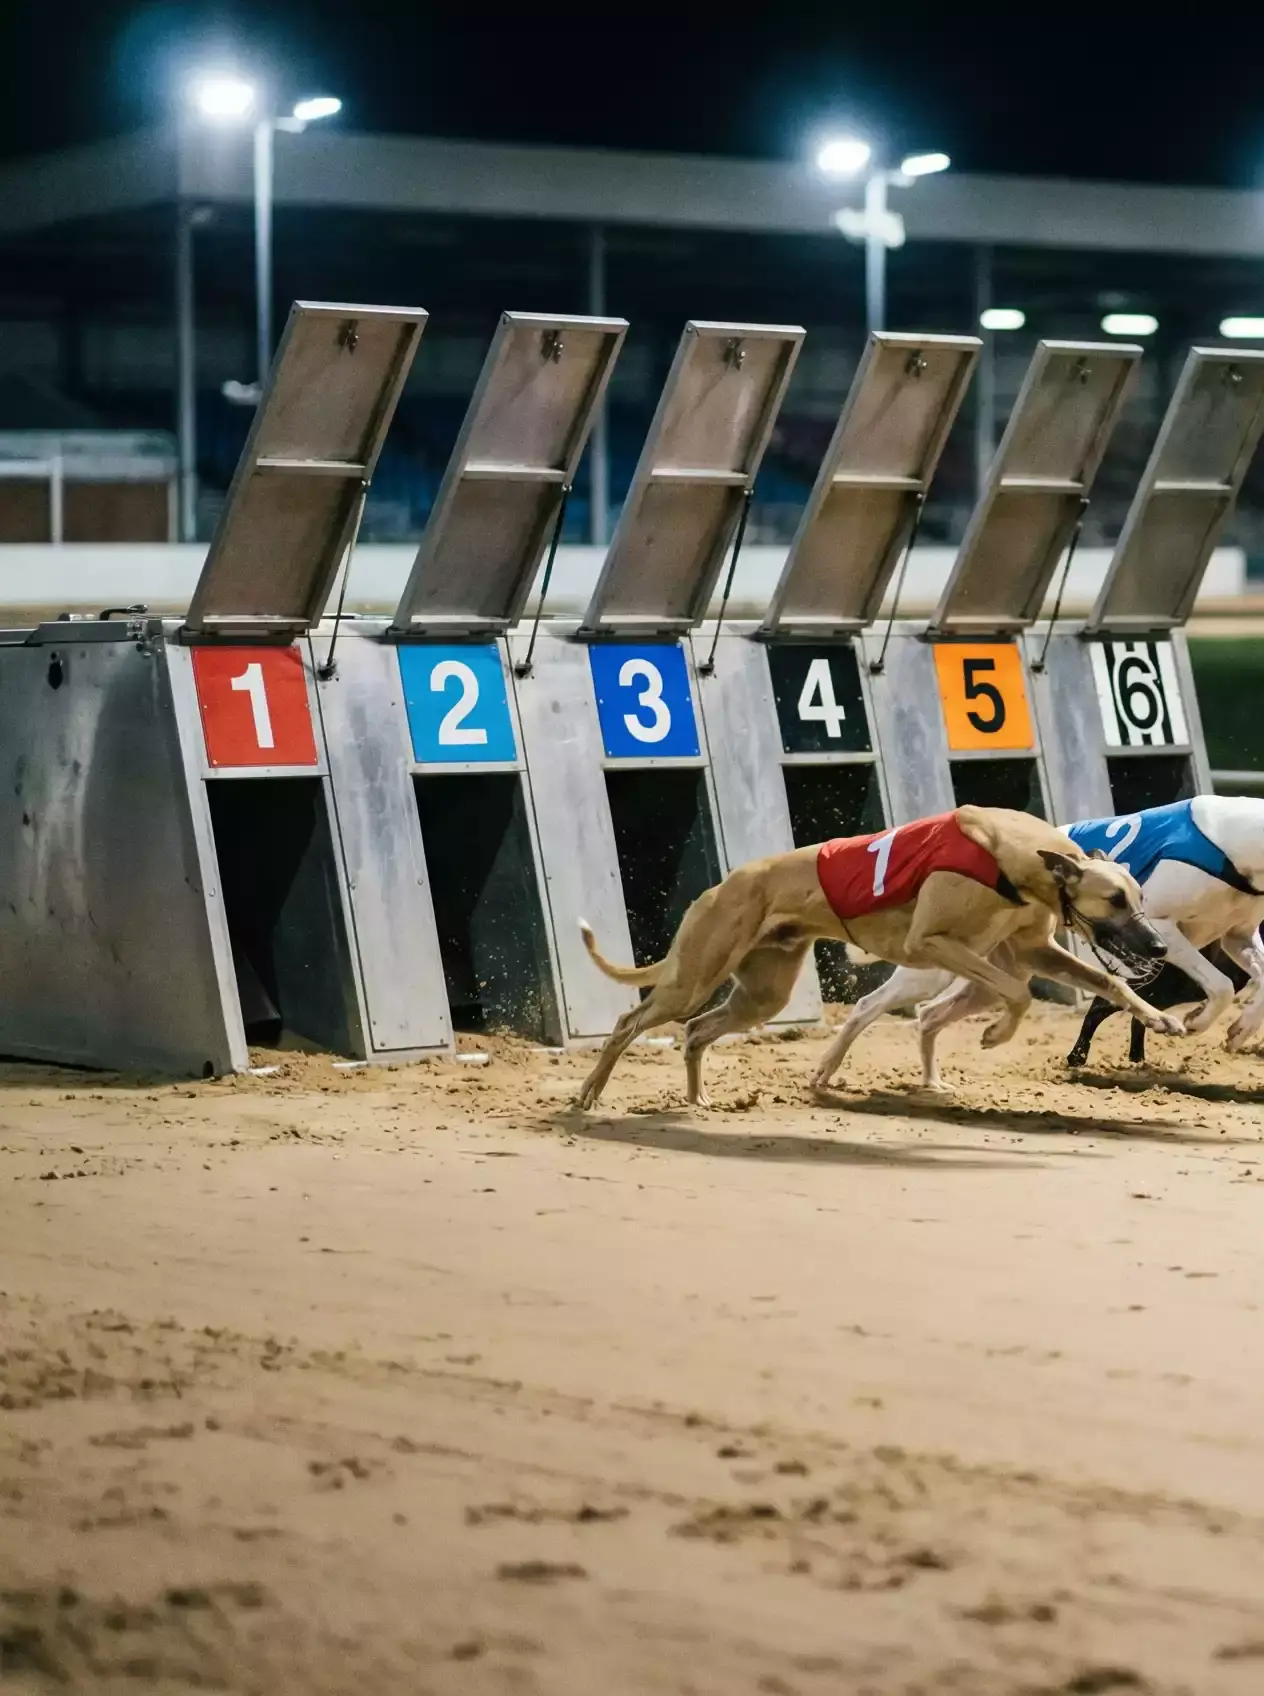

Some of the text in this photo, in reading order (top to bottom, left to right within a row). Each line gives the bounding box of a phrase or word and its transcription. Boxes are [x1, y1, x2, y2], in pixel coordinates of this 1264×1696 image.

[230, 662, 275, 749] 1
[429, 660, 489, 746] 2
[617, 658, 672, 743] 3
[797, 658, 846, 738] 4
[962, 657, 1006, 734] 5
[1117, 656, 1159, 730] 6
[867, 826, 898, 897] 1
[1105, 813, 1142, 872] 2
